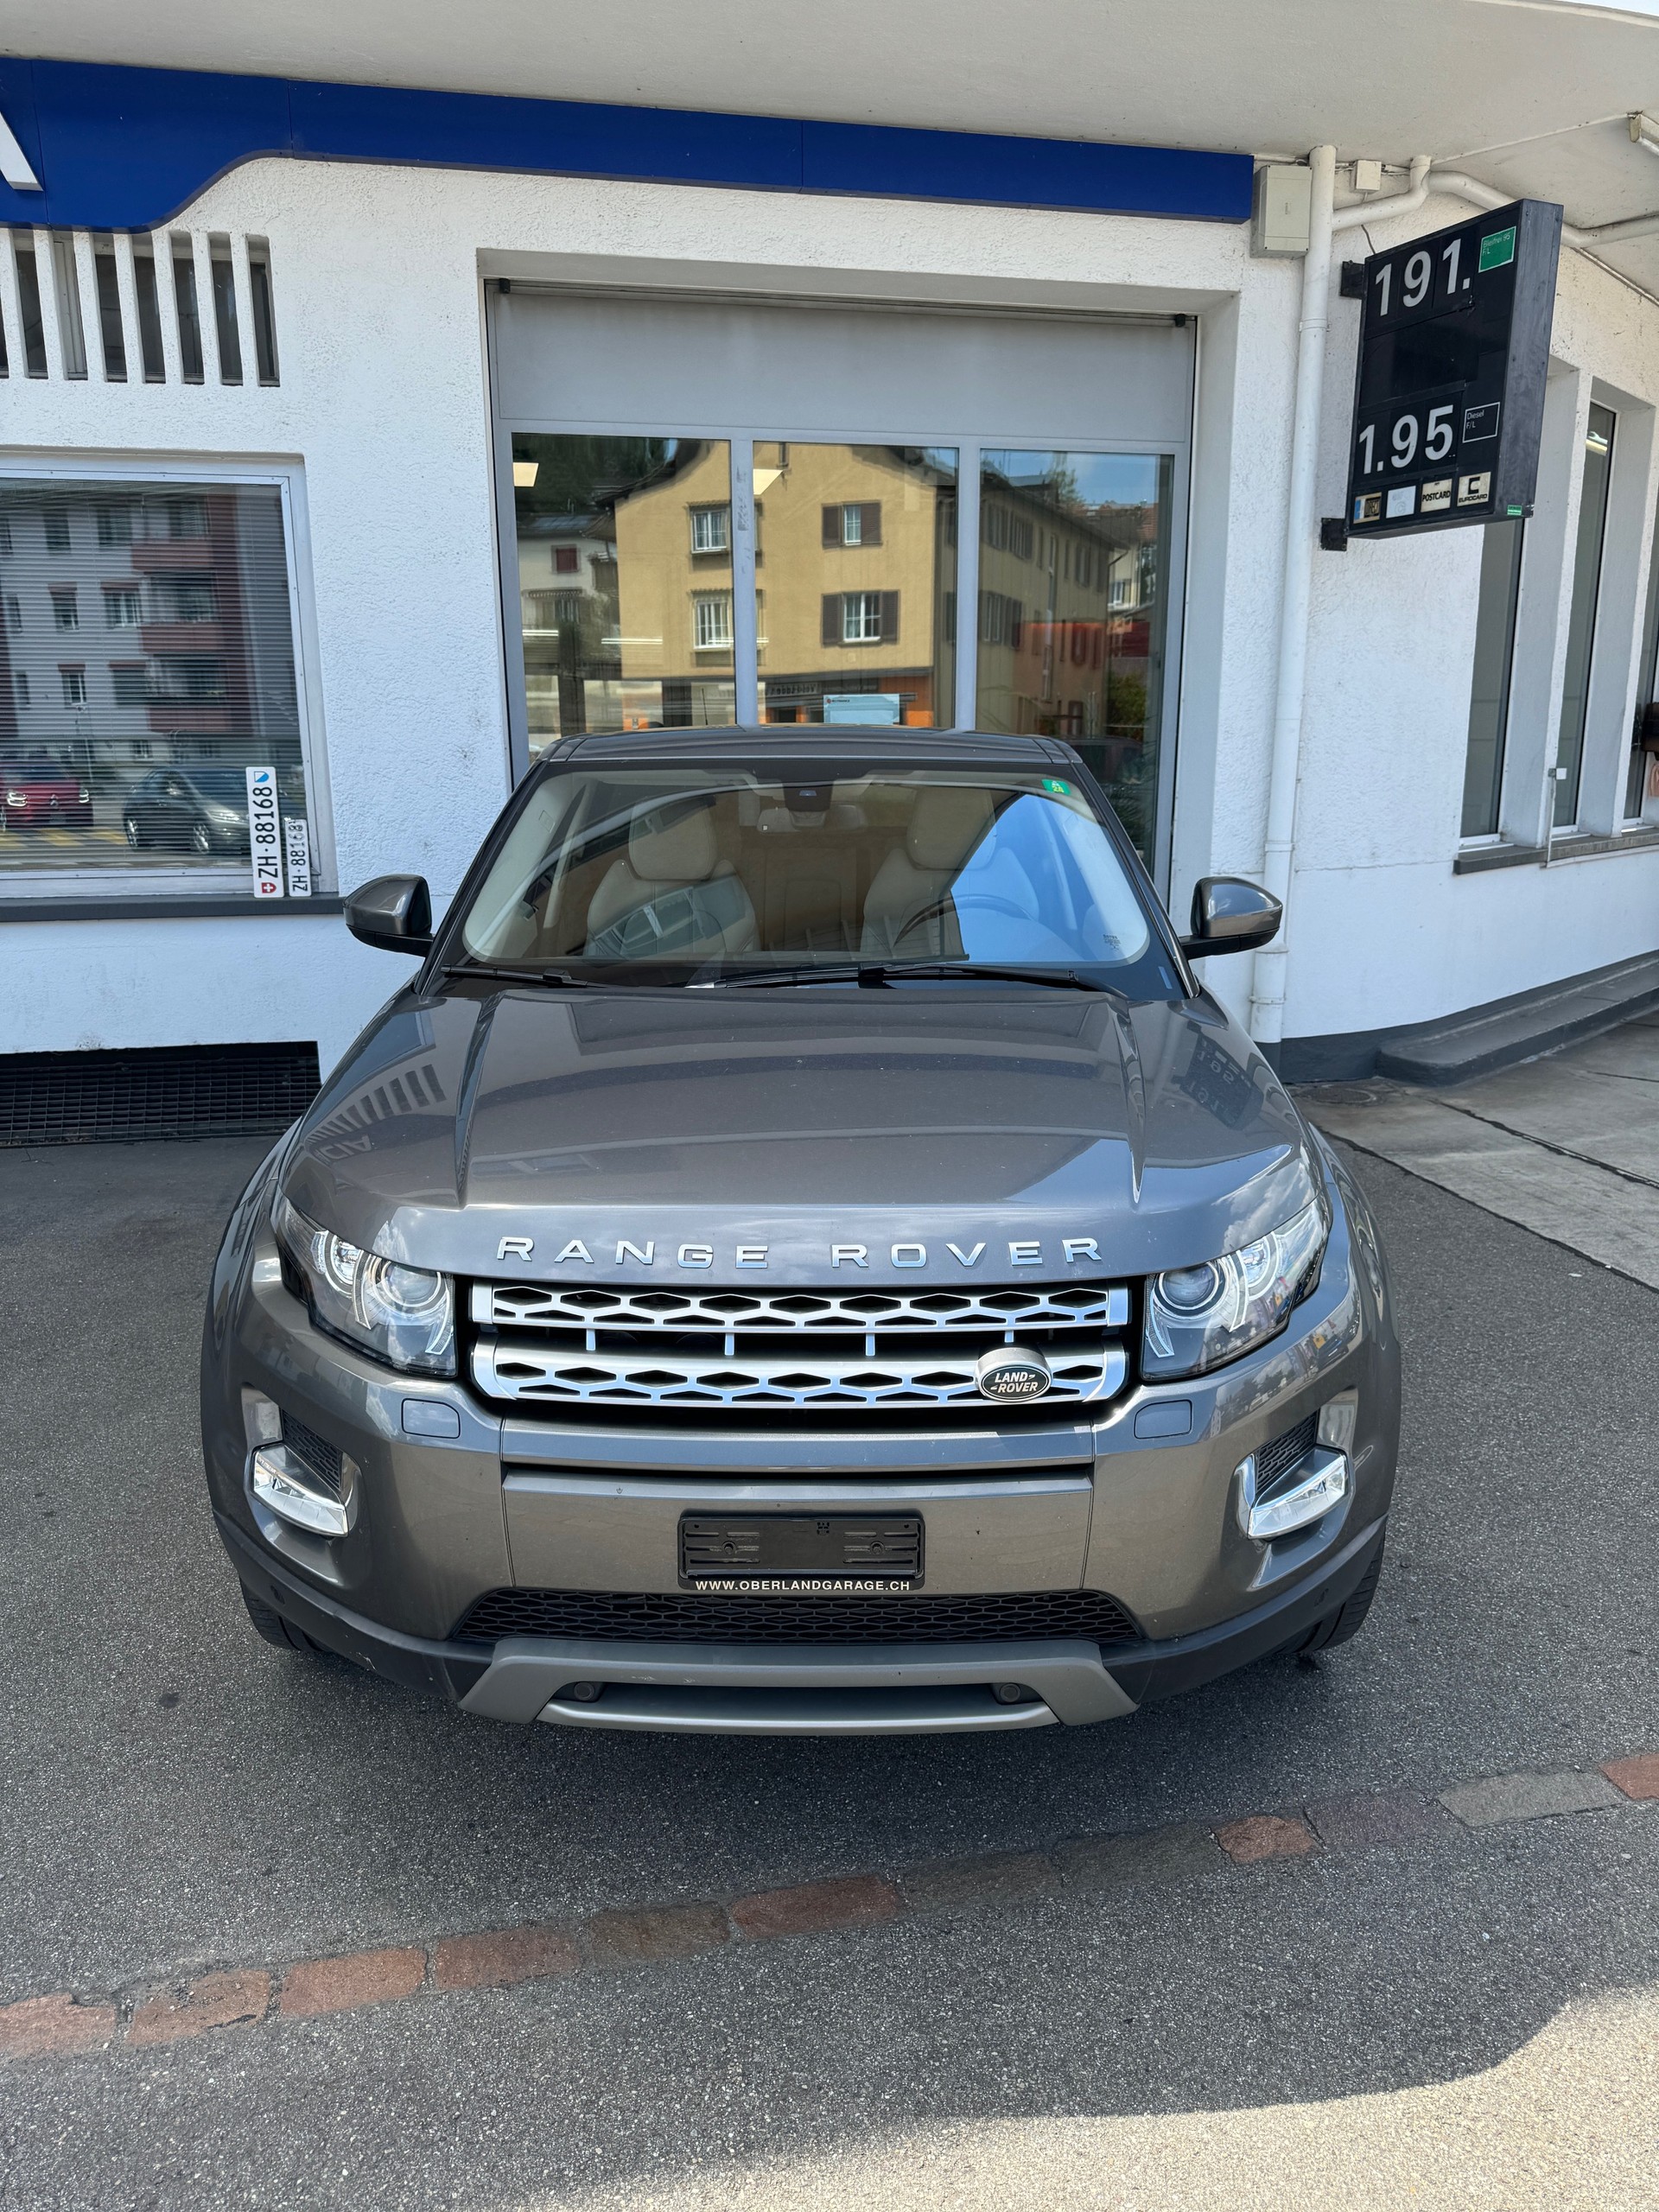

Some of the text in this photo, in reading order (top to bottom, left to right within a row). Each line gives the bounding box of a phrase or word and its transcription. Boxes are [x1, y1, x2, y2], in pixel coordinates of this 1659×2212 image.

[1467, 410, 1484, 420] Diesel
[1359, 404, 1453, 474] 1.95
[1421, 490, 1451, 502] POSTCARD
[1459, 493, 1488, 503] EUROCARD
[496, 1236, 1102, 1269] RANGE ROVER
[995, 1371, 1028, 1383] LAND
[997, 1382, 1039, 1393] ROVER
[696, 1580, 910, 1591] WWW.OBERLANDGARAGE.CH
